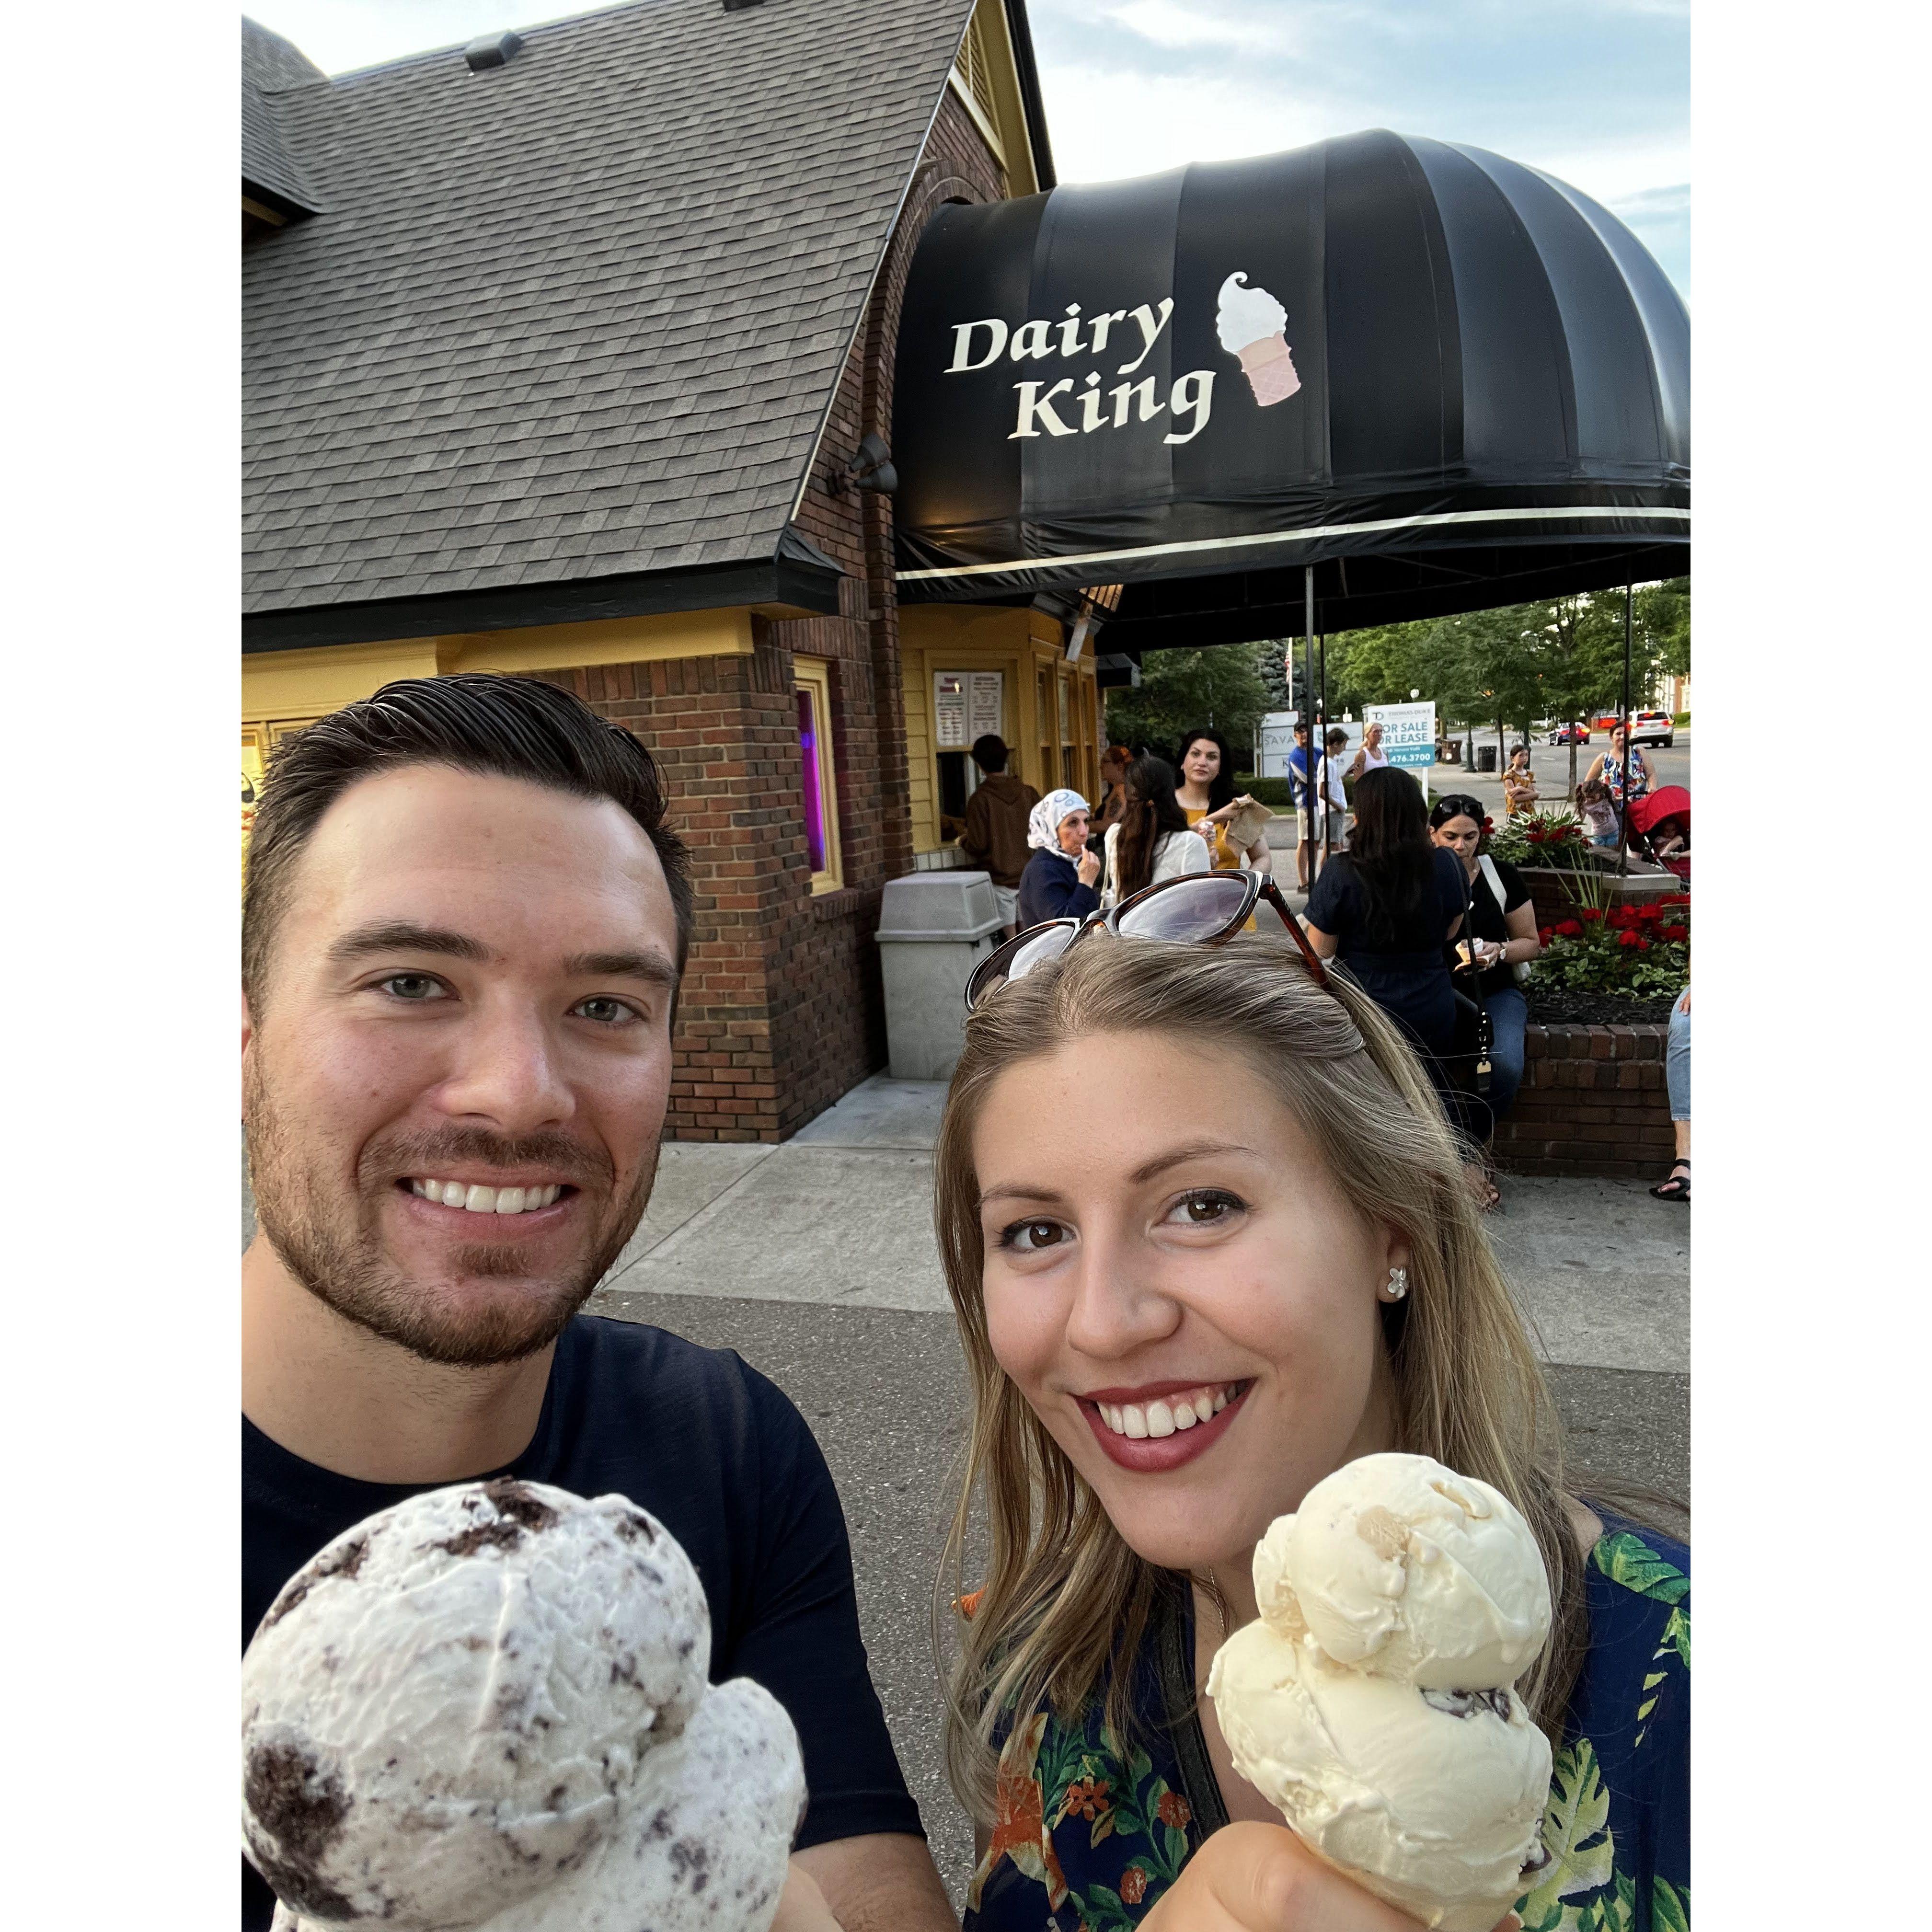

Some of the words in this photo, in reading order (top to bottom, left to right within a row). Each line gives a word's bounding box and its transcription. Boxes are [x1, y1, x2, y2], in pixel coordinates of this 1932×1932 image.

[943, 297, 1174, 375] Dairy
[1007, 370, 1217, 445] King
[1383, 724, 1398, 733] OR
[1401, 722, 1427, 732] SALE
[1395, 733, 1428, 743] LEASE
